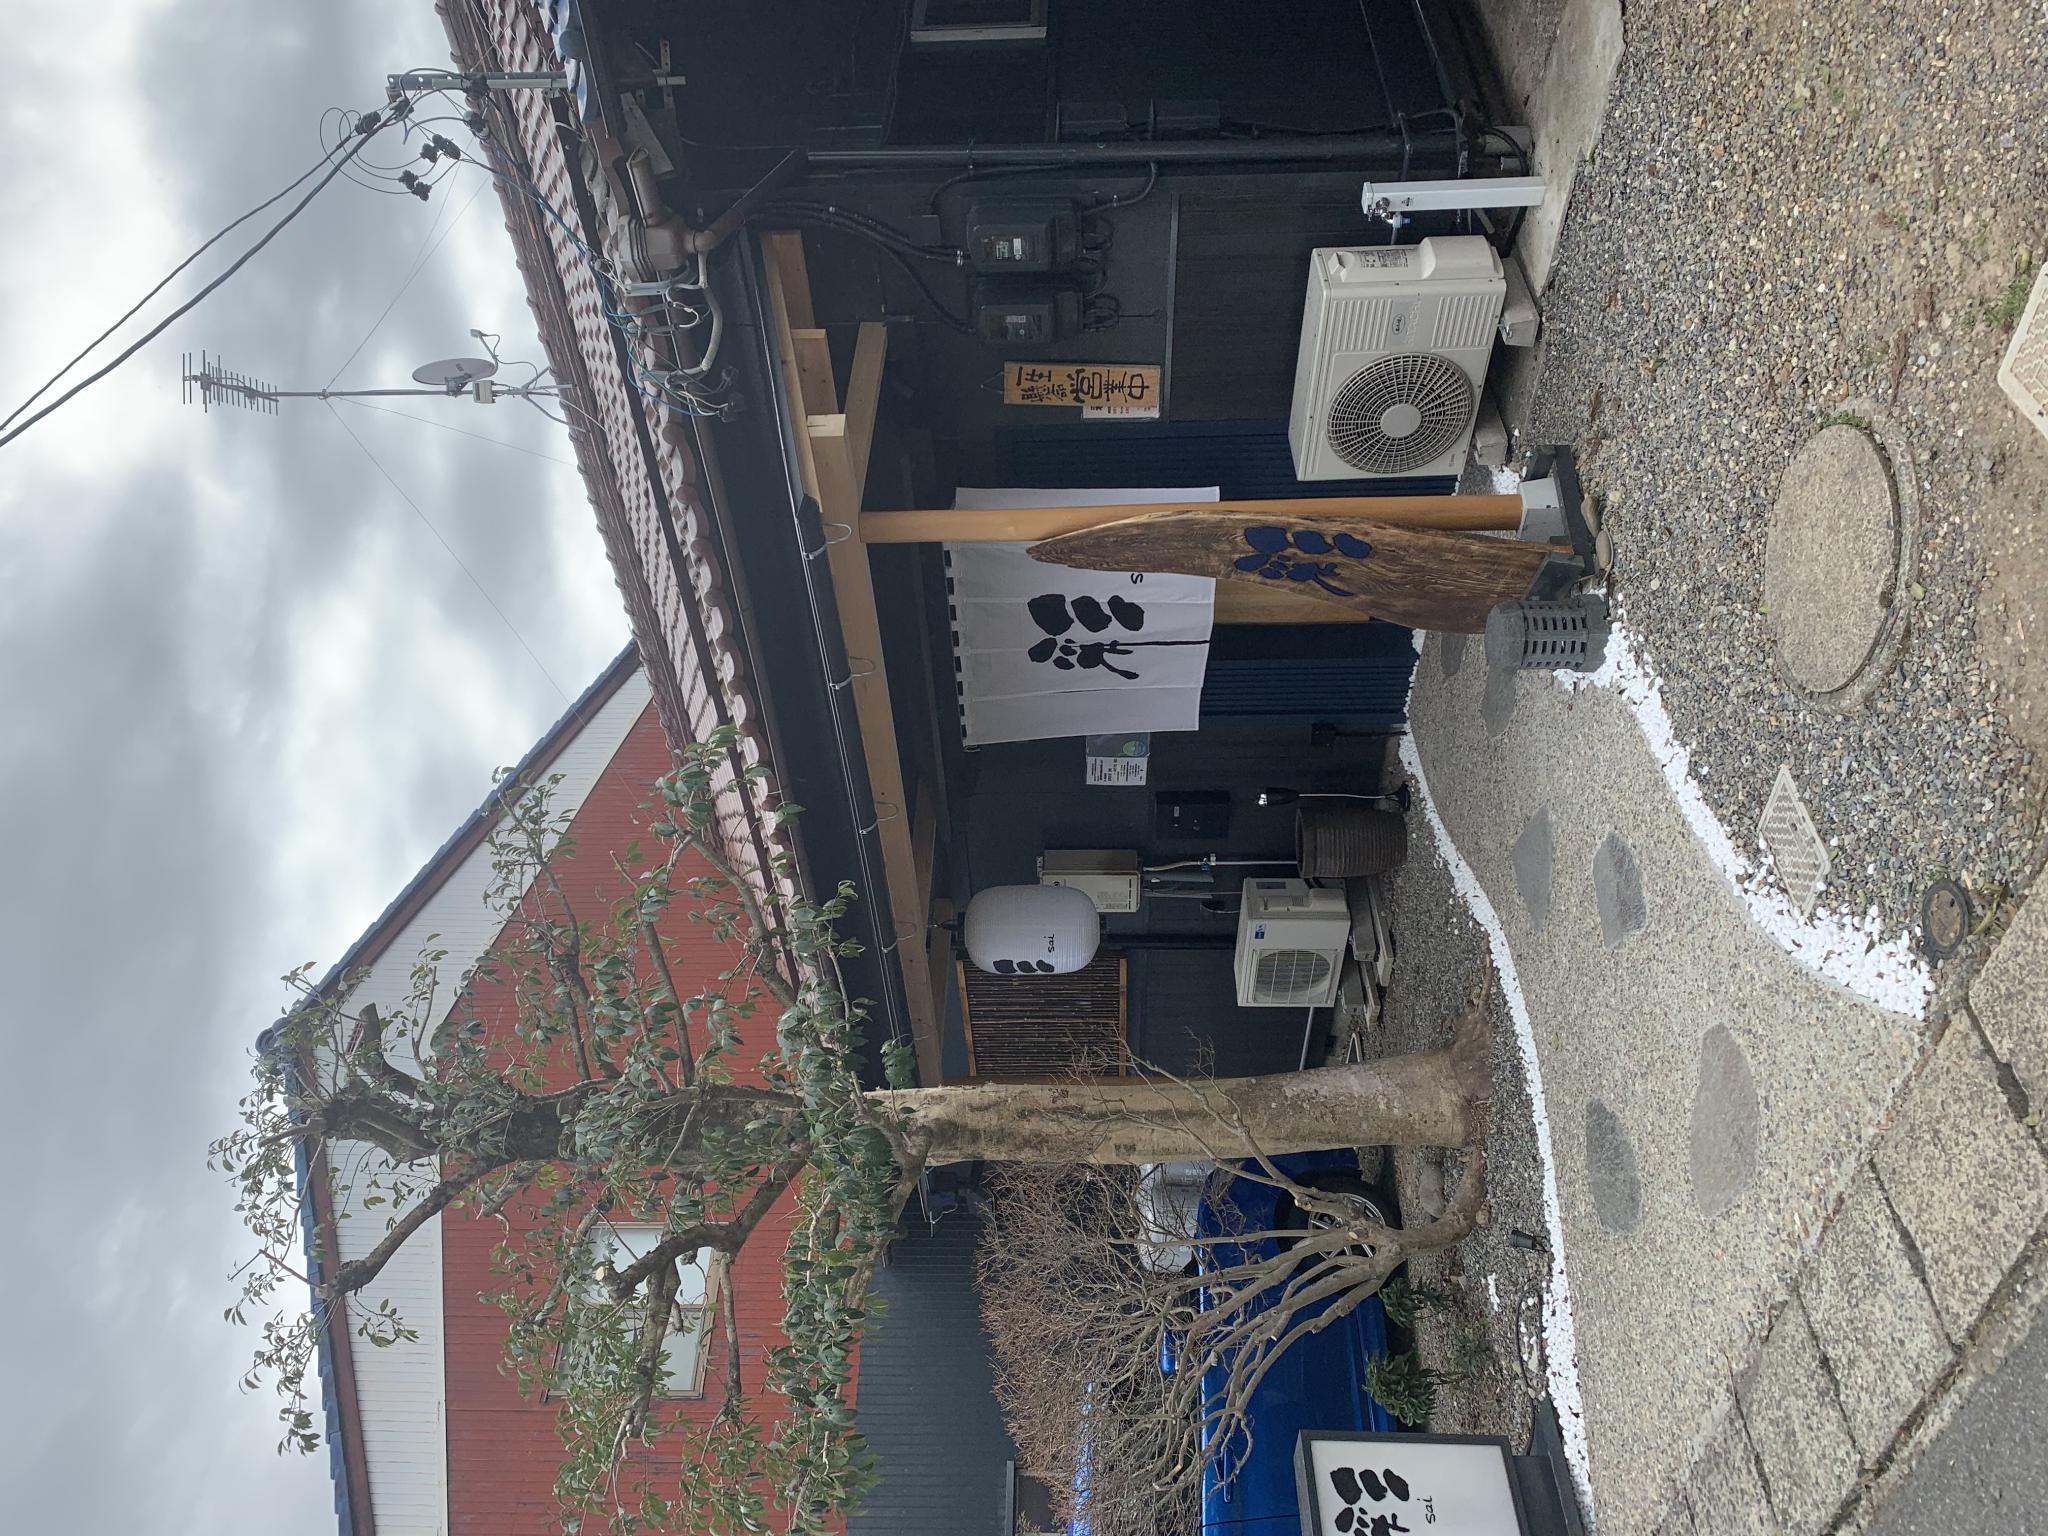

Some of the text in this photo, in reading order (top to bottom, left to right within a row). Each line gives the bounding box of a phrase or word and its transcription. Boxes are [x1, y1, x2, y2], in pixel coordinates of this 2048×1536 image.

[1066, 367, 1150, 404] 営業中
[1043, 933, 1055, 953] sai
[1416, 1495, 1436, 1525] sai
